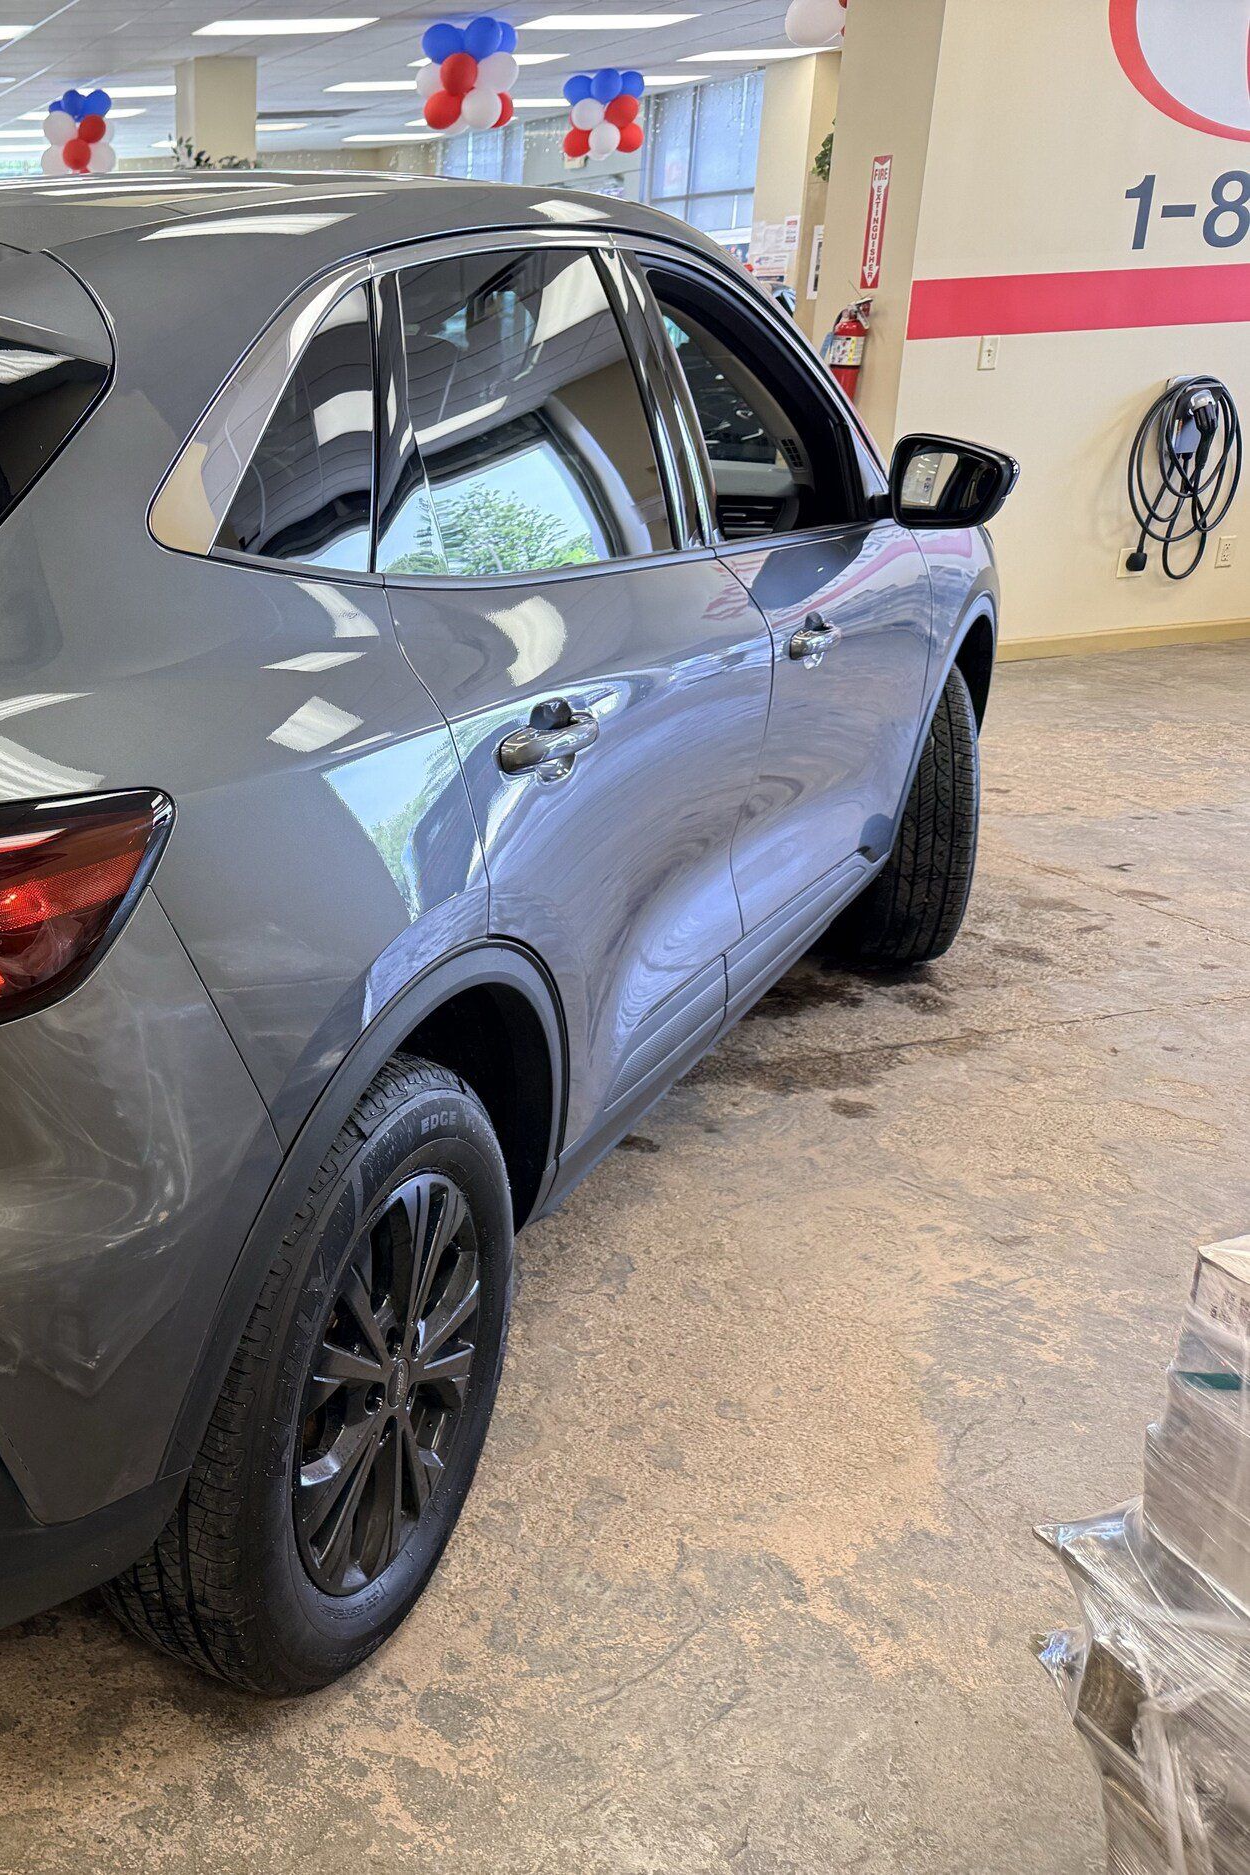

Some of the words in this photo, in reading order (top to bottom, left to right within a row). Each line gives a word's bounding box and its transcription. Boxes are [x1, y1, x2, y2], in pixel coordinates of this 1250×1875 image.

[873, 168, 889, 181] FIRE
[867, 185, 883, 278] EXTINGUISHER
[1125, 170, 1250, 250] 1-8
[421, 1110, 458, 1135] EDGE
